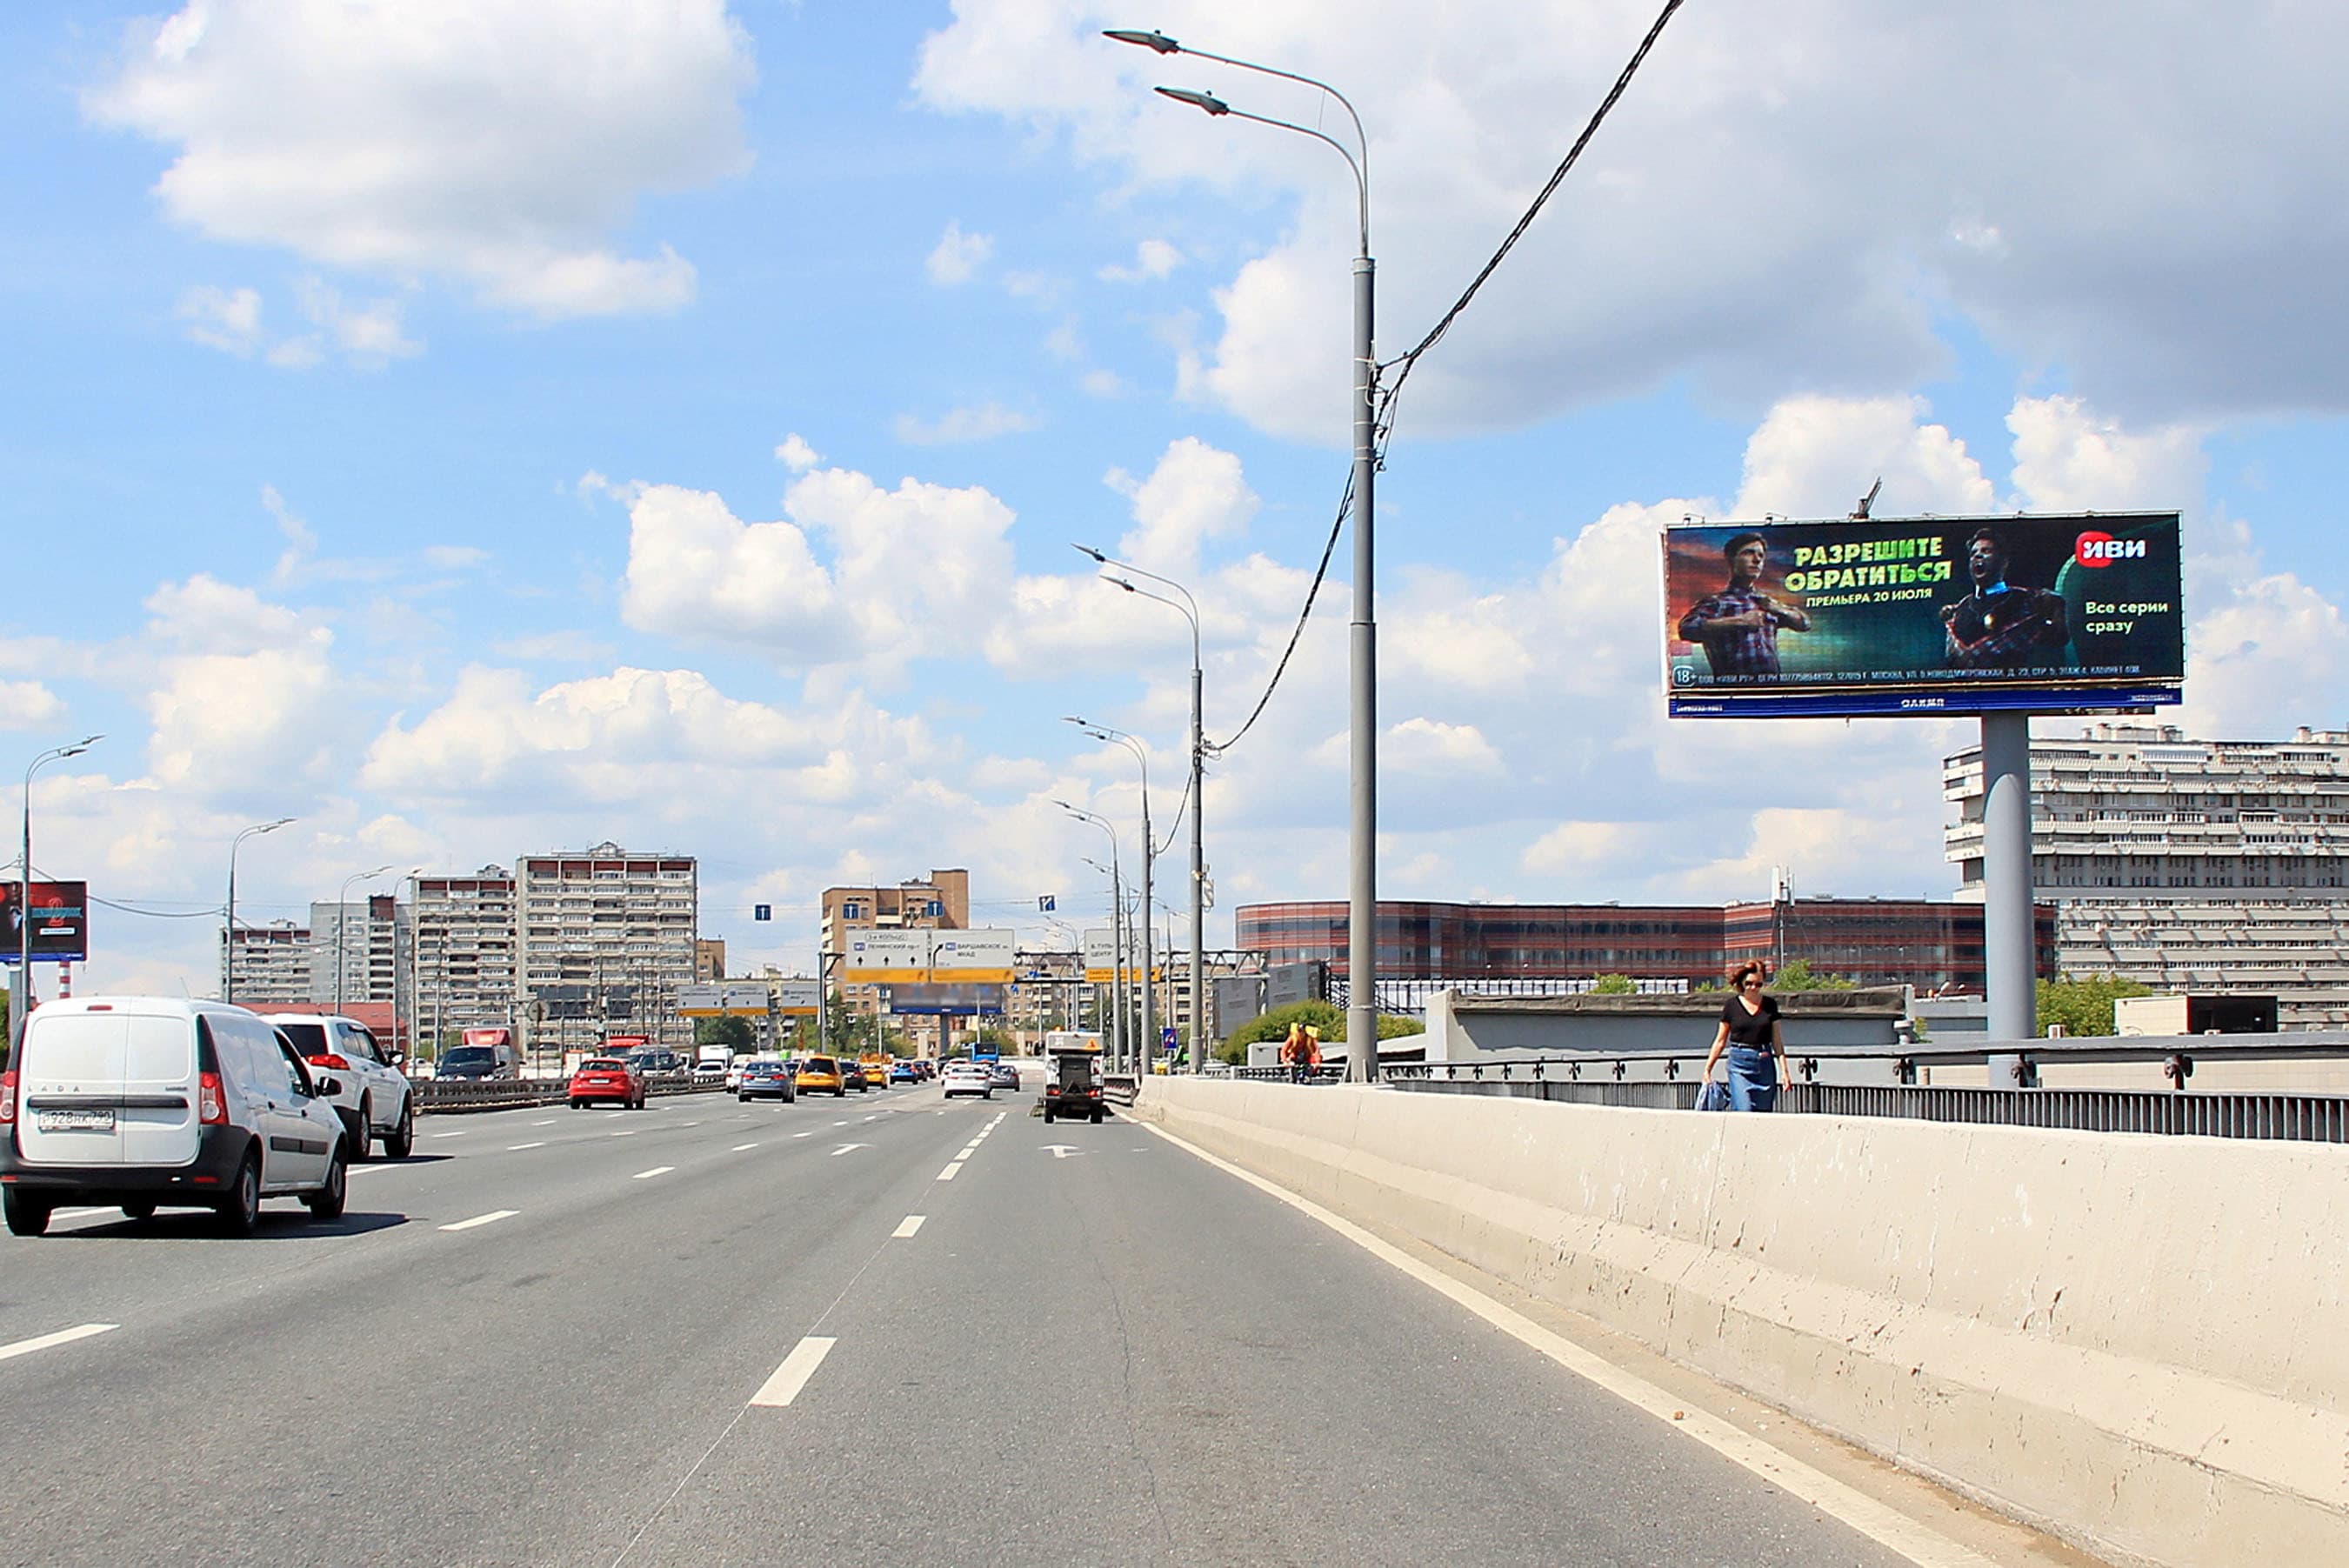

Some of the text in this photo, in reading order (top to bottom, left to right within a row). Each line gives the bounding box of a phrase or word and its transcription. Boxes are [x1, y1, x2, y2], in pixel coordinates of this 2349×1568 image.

[1794, 537, 1943, 567] РАЗРЕШИТЕ
[1785, 560, 1952, 592] ОБРАТИТЬСЯ
[1805, 588, 1933, 608] ПРЕМЬЕРА 20 ИЮЛЯ
[2085, 602, 2168, 617] Все серии
[2085, 621, 2133, 635] сразу
[1676, 669, 1697, 684] 18+
